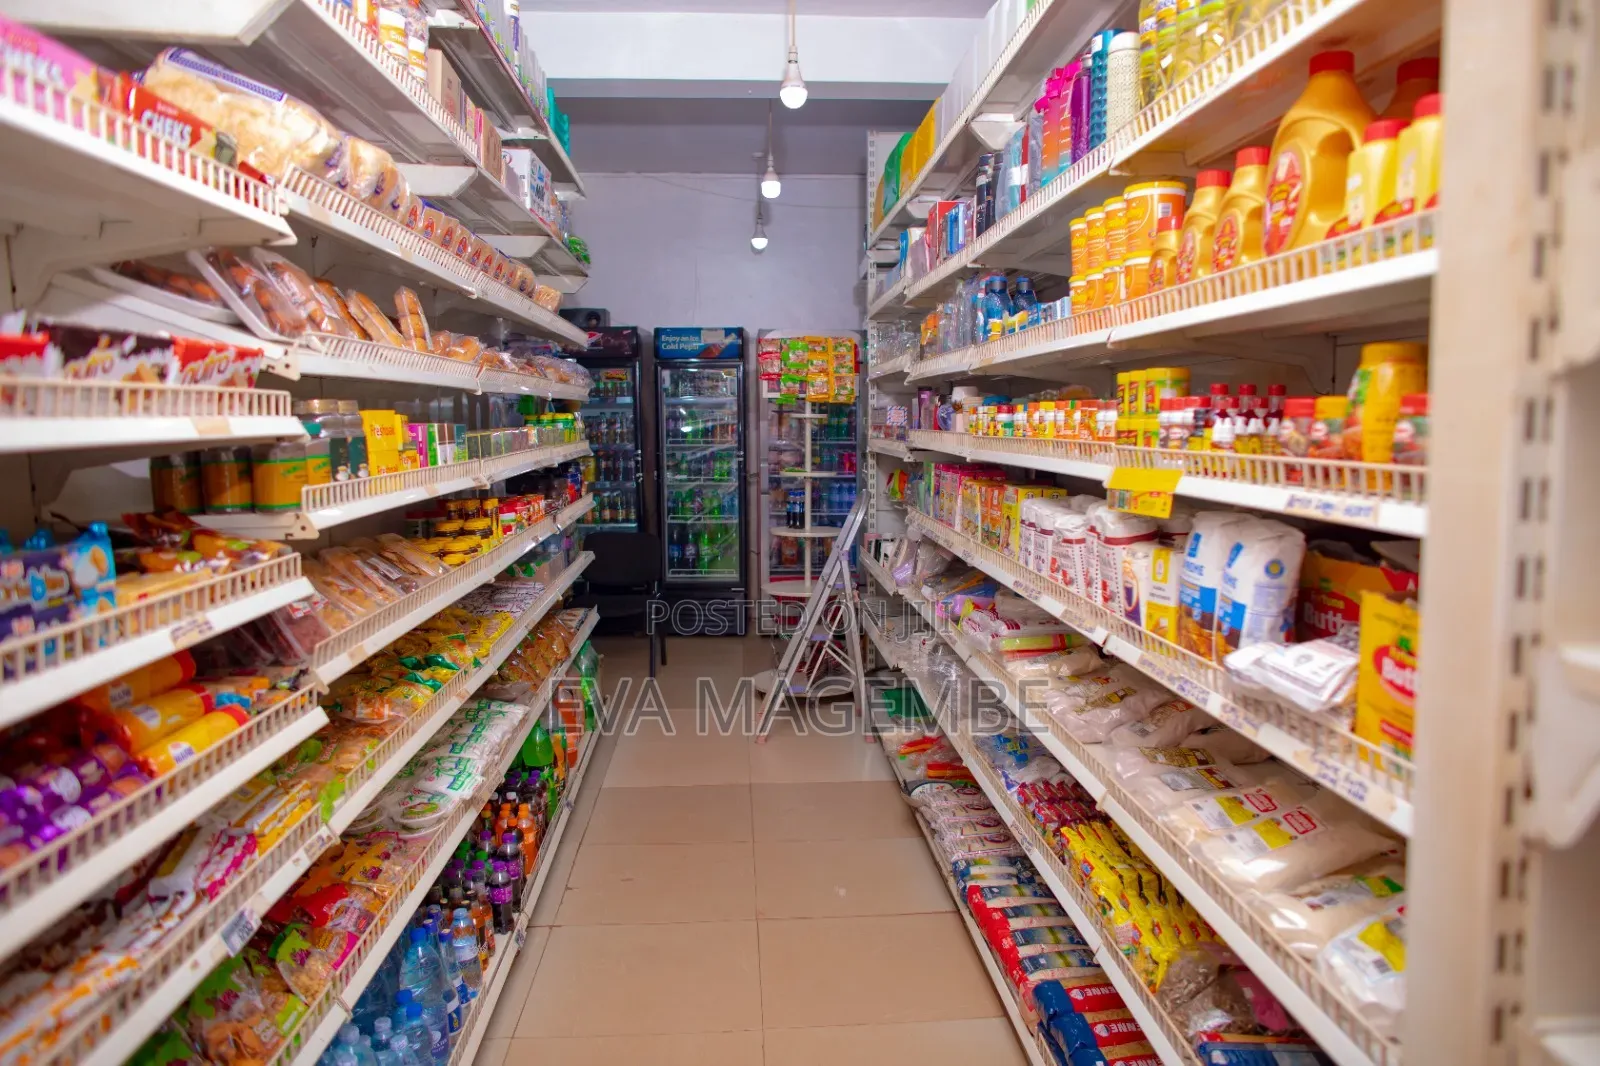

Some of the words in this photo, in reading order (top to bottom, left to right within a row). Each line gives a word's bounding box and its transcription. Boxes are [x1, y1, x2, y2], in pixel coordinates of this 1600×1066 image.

[140, 108, 193, 150] CHEKS
[661, 334, 680, 343] Enjoy
[1084, 985, 1118, 997] ENNE
[1110, 1021, 1142, 1033] ENNE
